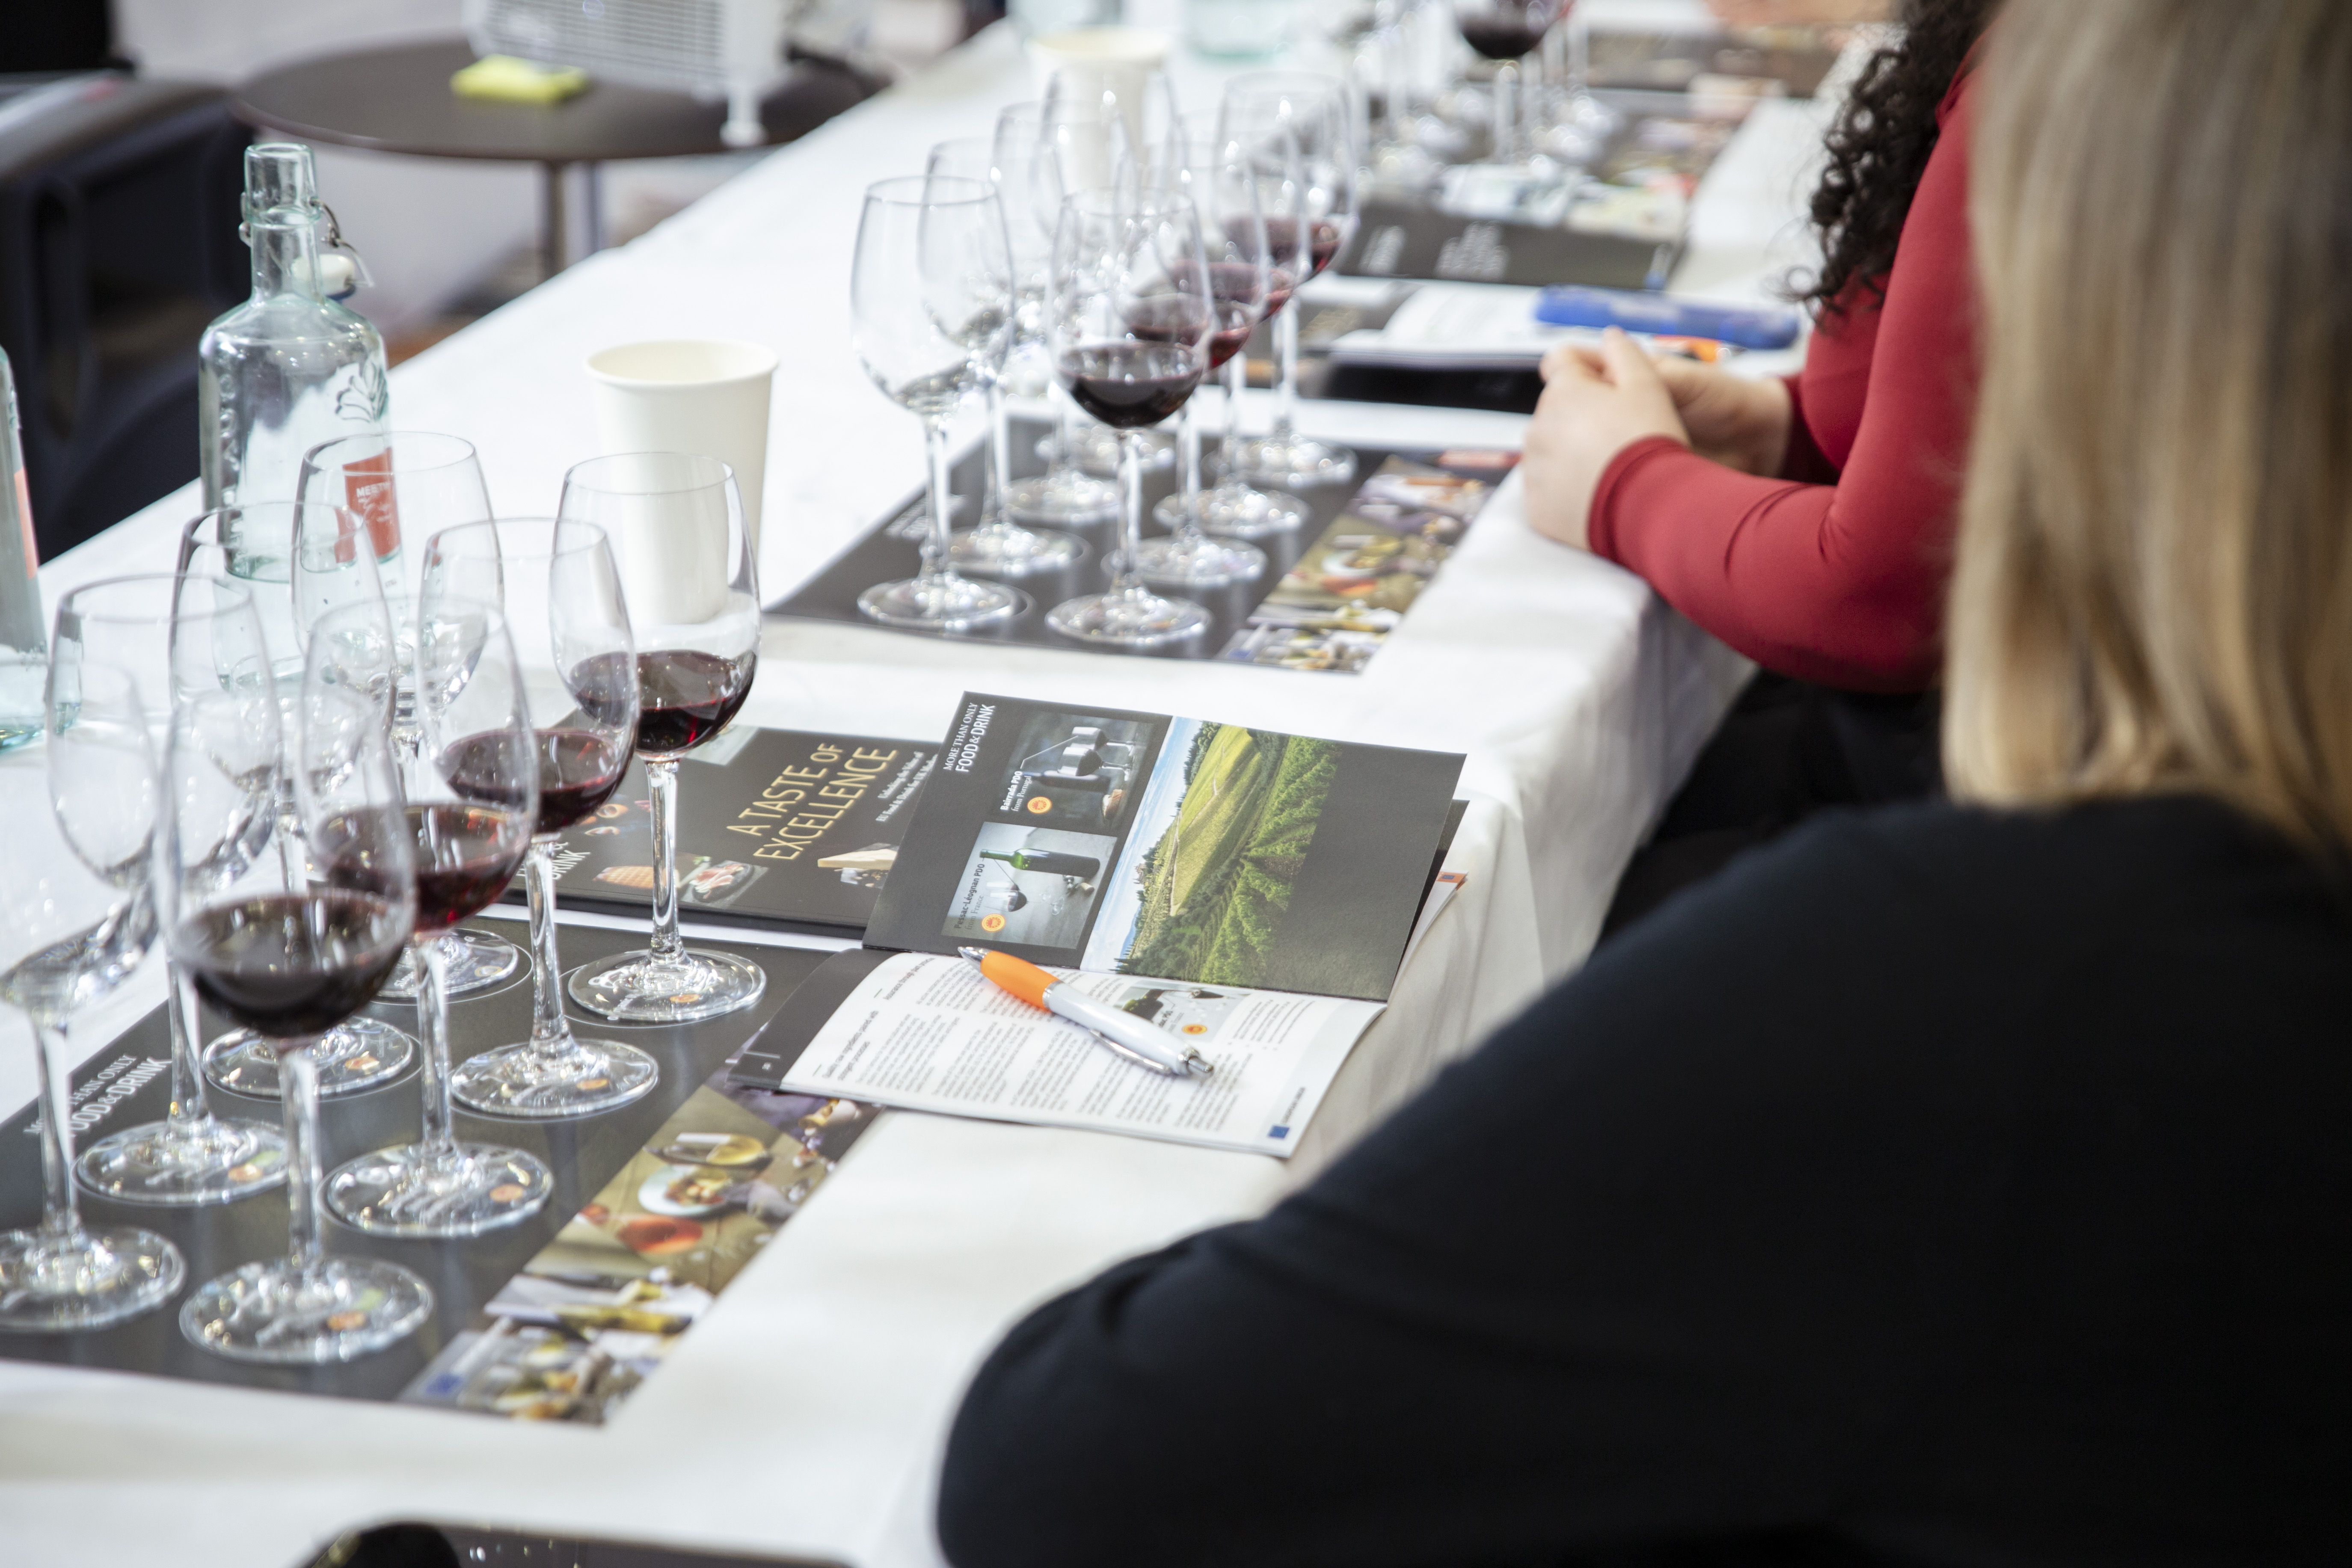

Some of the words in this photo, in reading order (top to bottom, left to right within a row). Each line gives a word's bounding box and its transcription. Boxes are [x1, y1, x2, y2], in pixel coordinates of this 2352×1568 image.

[970, 704, 996, 736] DRINK
[943, 747, 960, 771] MORE
[952, 724, 969, 746] THAN
[963, 702, 978, 724] ONLY
[969, 735, 980, 744] &
[810, 742, 844, 763] OF
[955, 744, 979, 772] FOOD
[738, 765, 828, 818] TASTE
[1000, 784, 1018, 811] Bairrada
[1011, 771, 1023, 784] PDO
[1016, 775, 1032, 797] Portugal
[753, 746, 899, 860] EXCELLENCE
[875, 814, 889, 822] EU
[882, 803, 899, 815] Food
[896, 787, 915, 800] Drink
[1011, 798, 1023, 812] from
[726, 824, 771, 836] A
[973, 863, 985, 877] PDO
[964, 917, 976, 930] from
[970, 895, 984, 914] France
[97, 1054, 138, 1079] ONLY
[105, 1056, 172, 1095] DRINK
[97, 1094, 122, 1104] &
